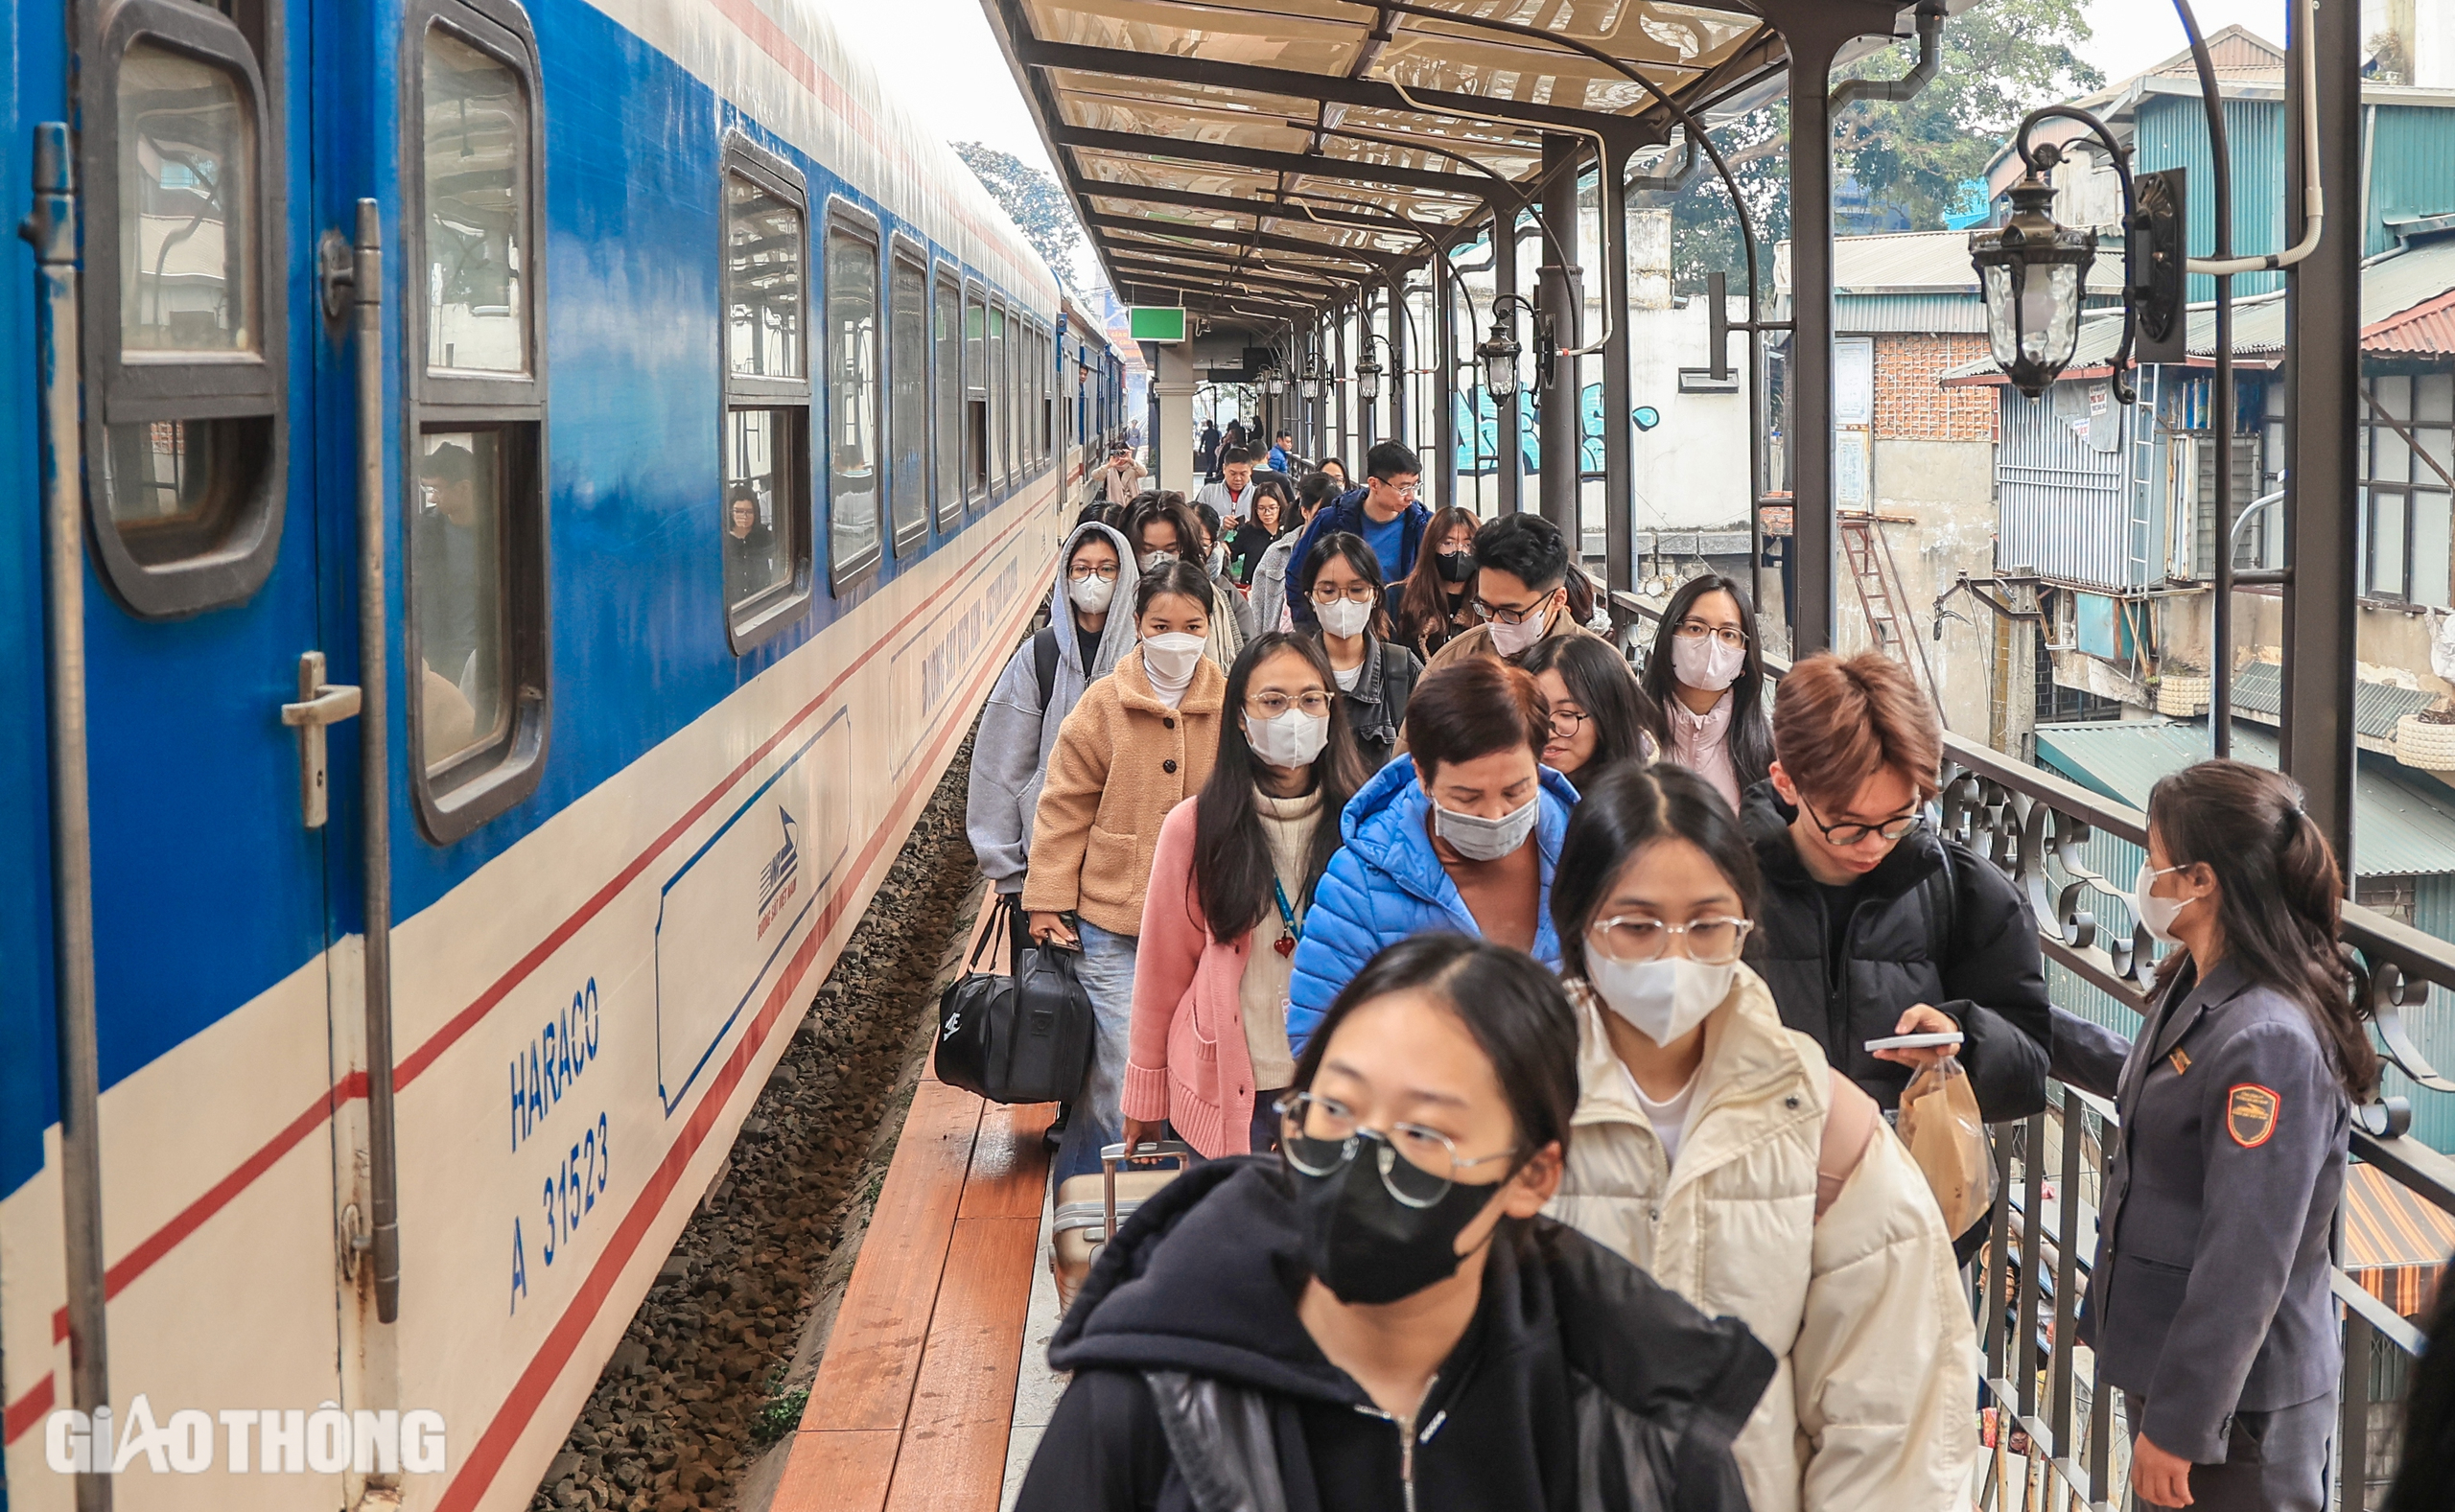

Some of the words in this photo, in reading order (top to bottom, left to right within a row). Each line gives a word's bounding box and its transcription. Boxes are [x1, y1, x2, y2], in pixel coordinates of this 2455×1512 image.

[509, 976, 599, 1154] HARACO
[509, 1215, 527, 1317] A
[543, 1111, 609, 1268] 31523
